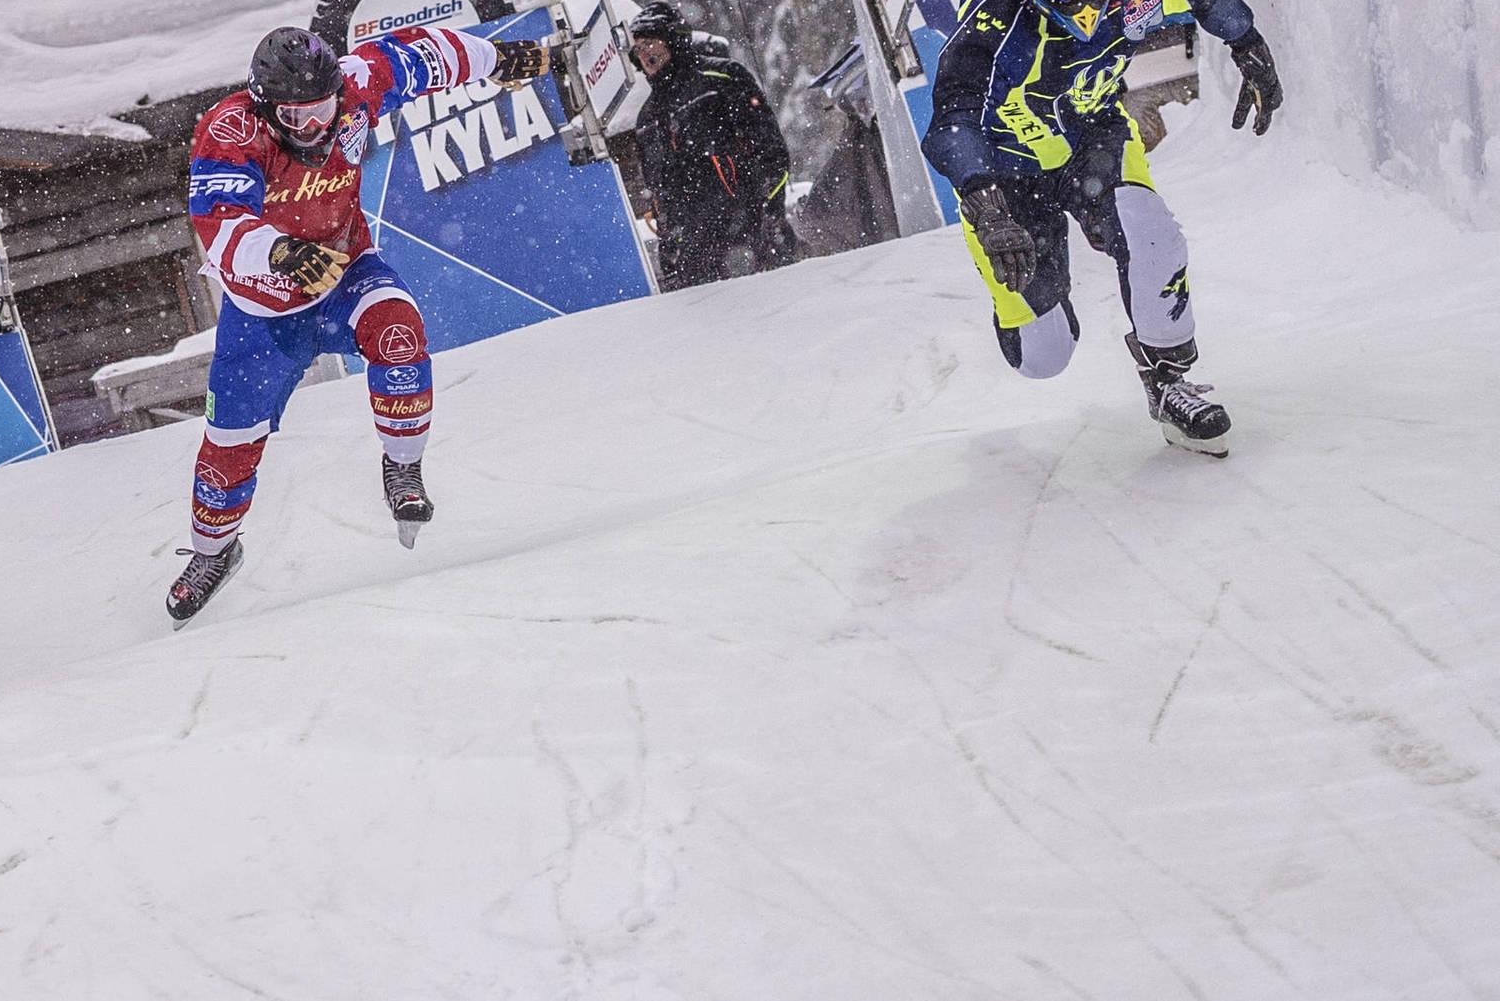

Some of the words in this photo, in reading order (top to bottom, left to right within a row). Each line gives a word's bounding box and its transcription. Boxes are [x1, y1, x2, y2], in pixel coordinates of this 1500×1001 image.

[1124, 6, 1143, 26] Red
[585, 38, 617, 90] NISSAN
[373, 397, 389, 413] Tim
